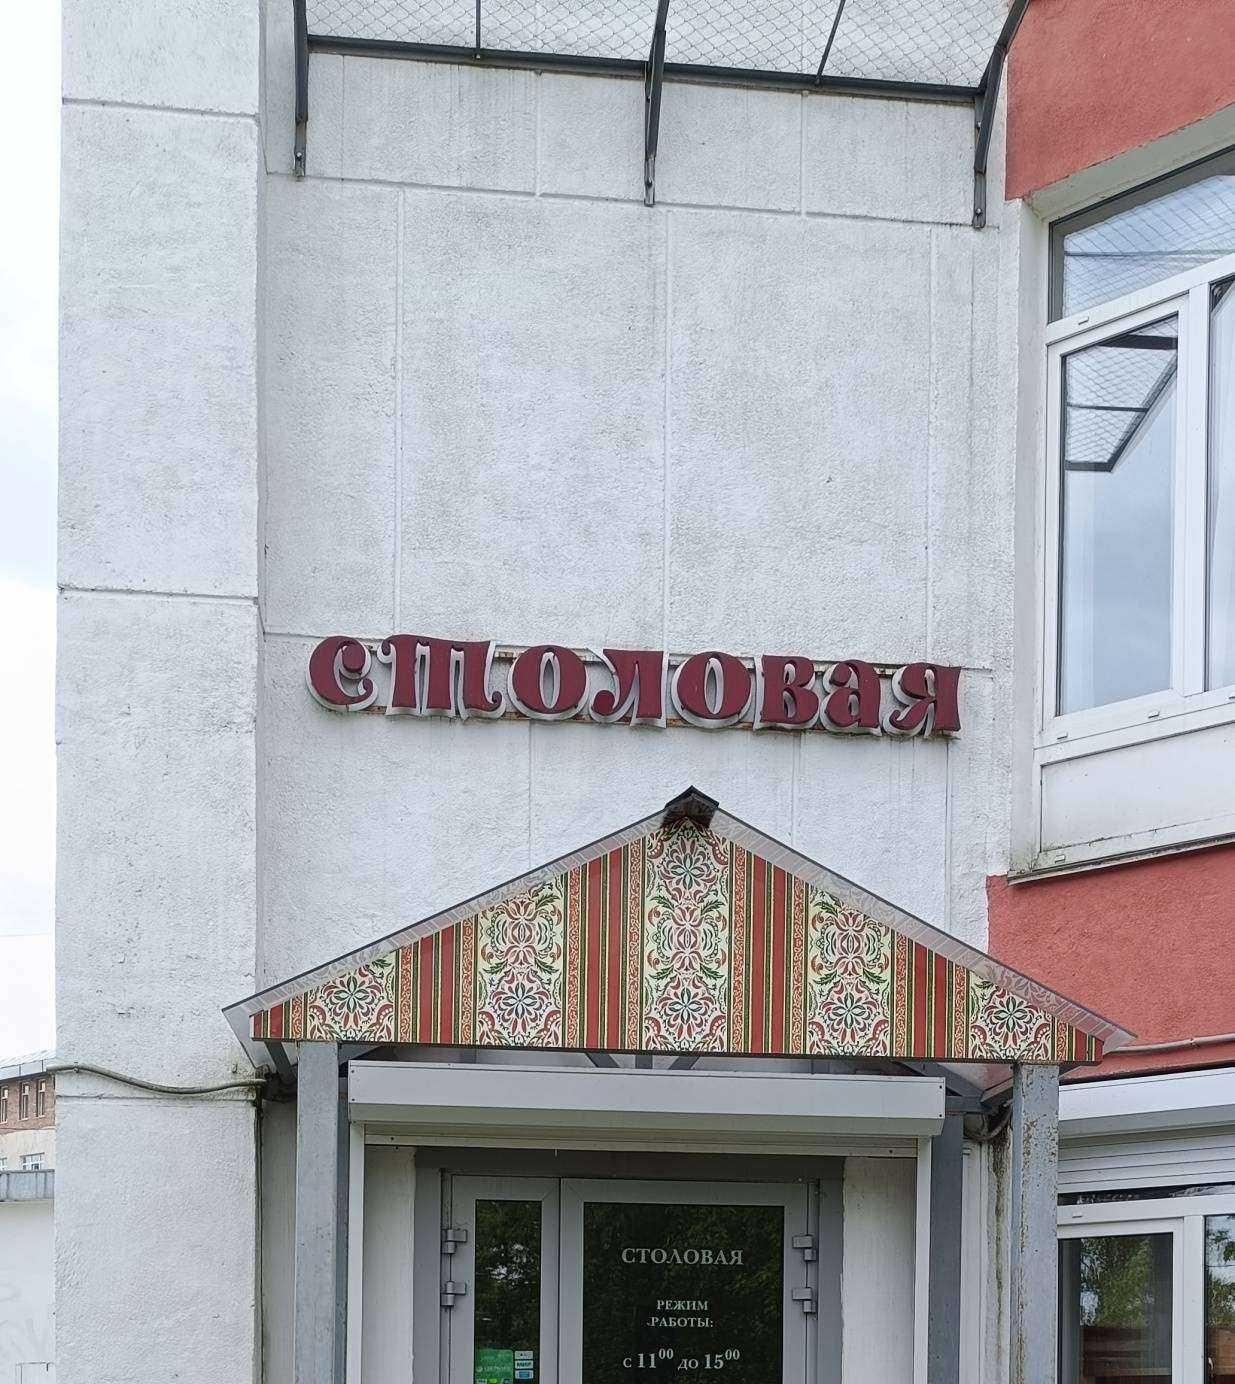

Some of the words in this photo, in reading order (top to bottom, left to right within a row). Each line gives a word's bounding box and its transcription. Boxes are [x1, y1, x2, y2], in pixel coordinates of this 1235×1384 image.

[621, 1247, 745, 1266] СТОЛОВАЯ
[656, 1299, 709, 1311] РЕЖИМ
[649, 1316, 714, 1328] РАБОТЫ:
